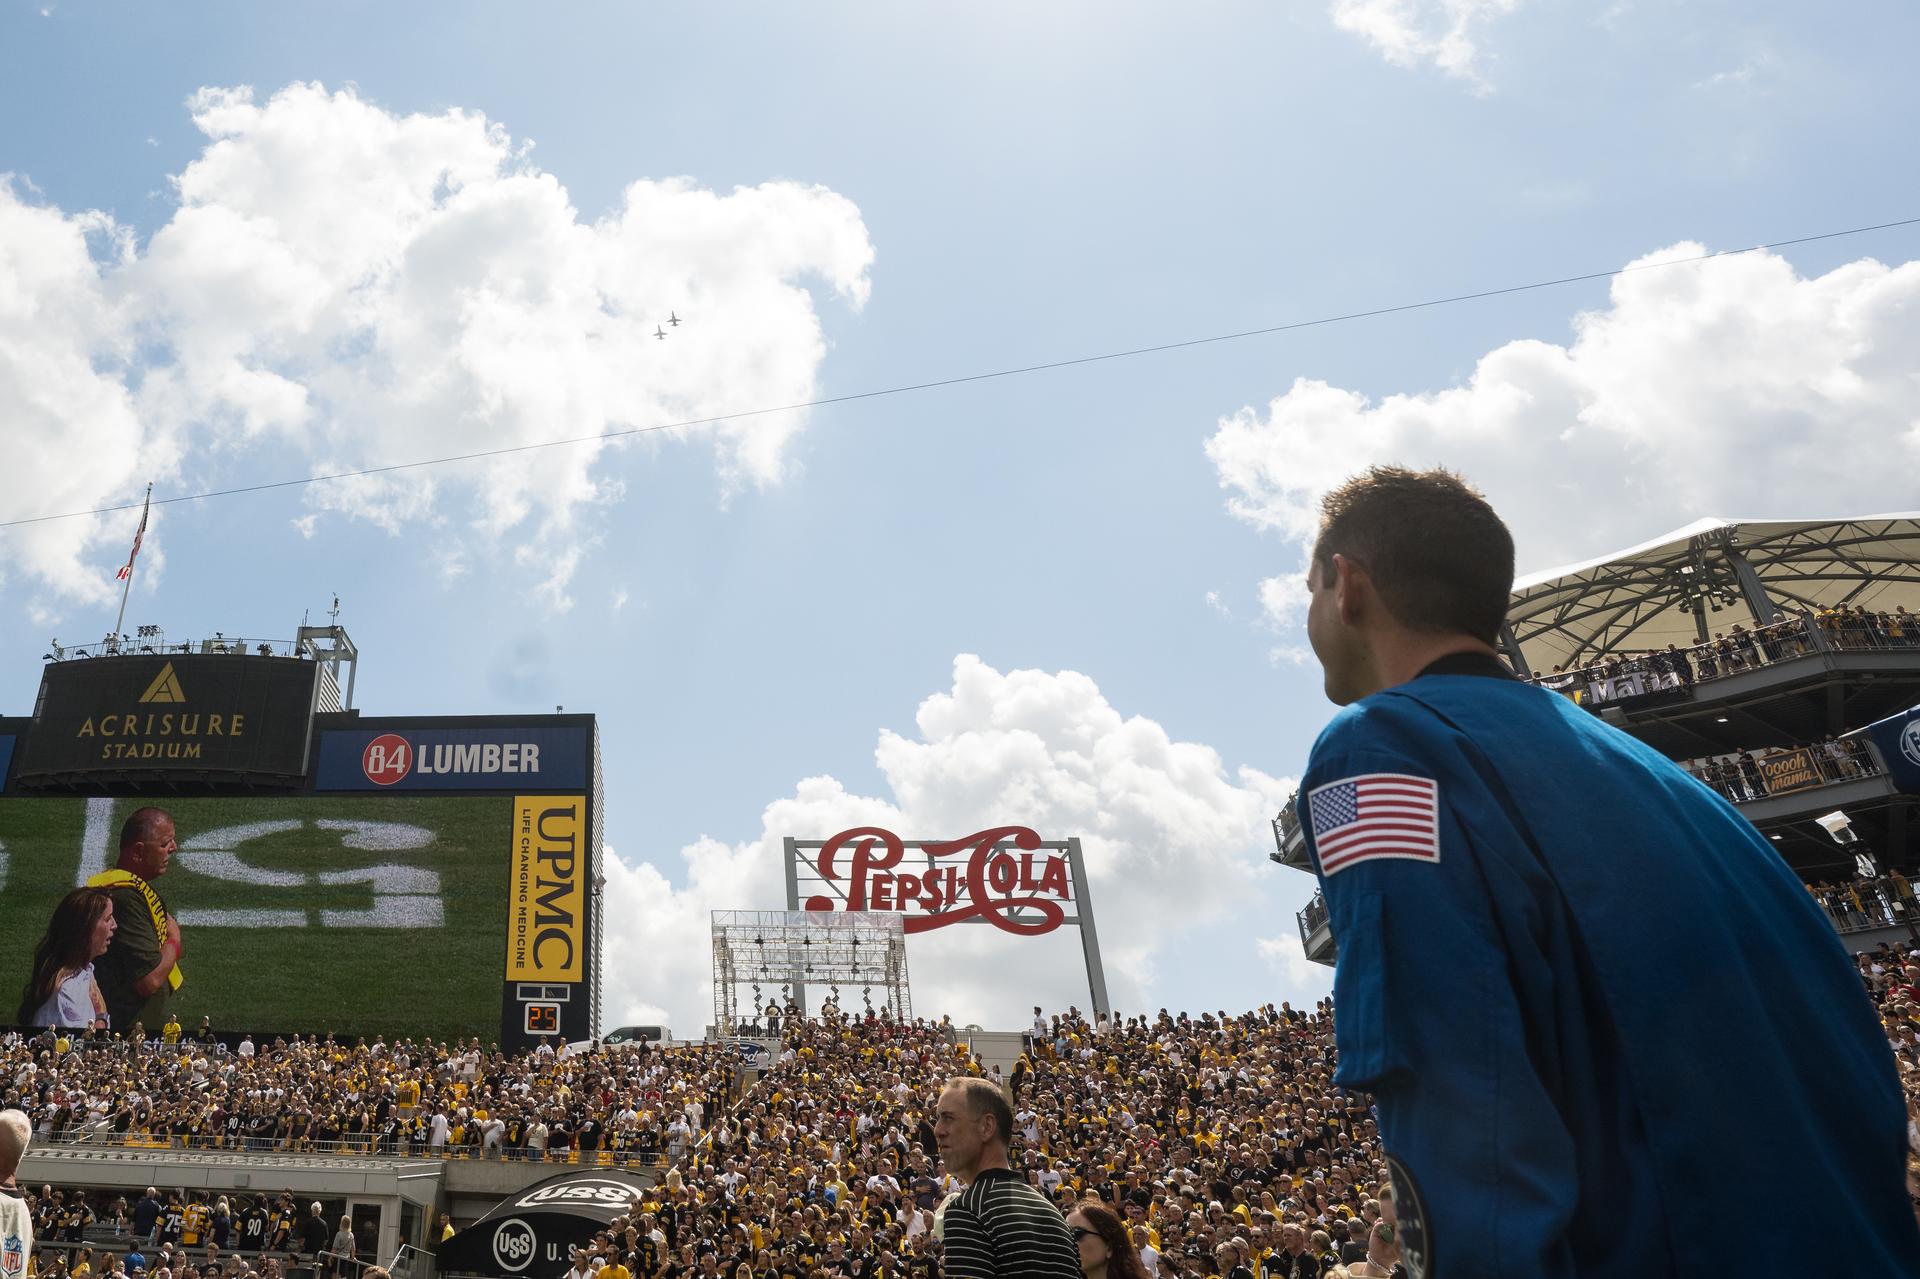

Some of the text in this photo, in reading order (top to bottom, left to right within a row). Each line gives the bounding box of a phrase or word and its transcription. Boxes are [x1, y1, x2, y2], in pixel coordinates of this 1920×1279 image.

[76, 713, 244, 737] ACRISURE
[102, 743, 201, 759] STADIUM
[368, 743, 540, 774] 84 LUMBER
[516, 808, 531, 970] LIFE CHANGING MEDICINE
[532, 804, 576, 970] UPMC
[528, 1006, 556, 1030] 25
[534, 1186, 631, 1202] USS
[247, 1219, 262, 1236] 90
[500, 1232, 530, 1260] USS
[4, 1251, 21, 1271] NFL
